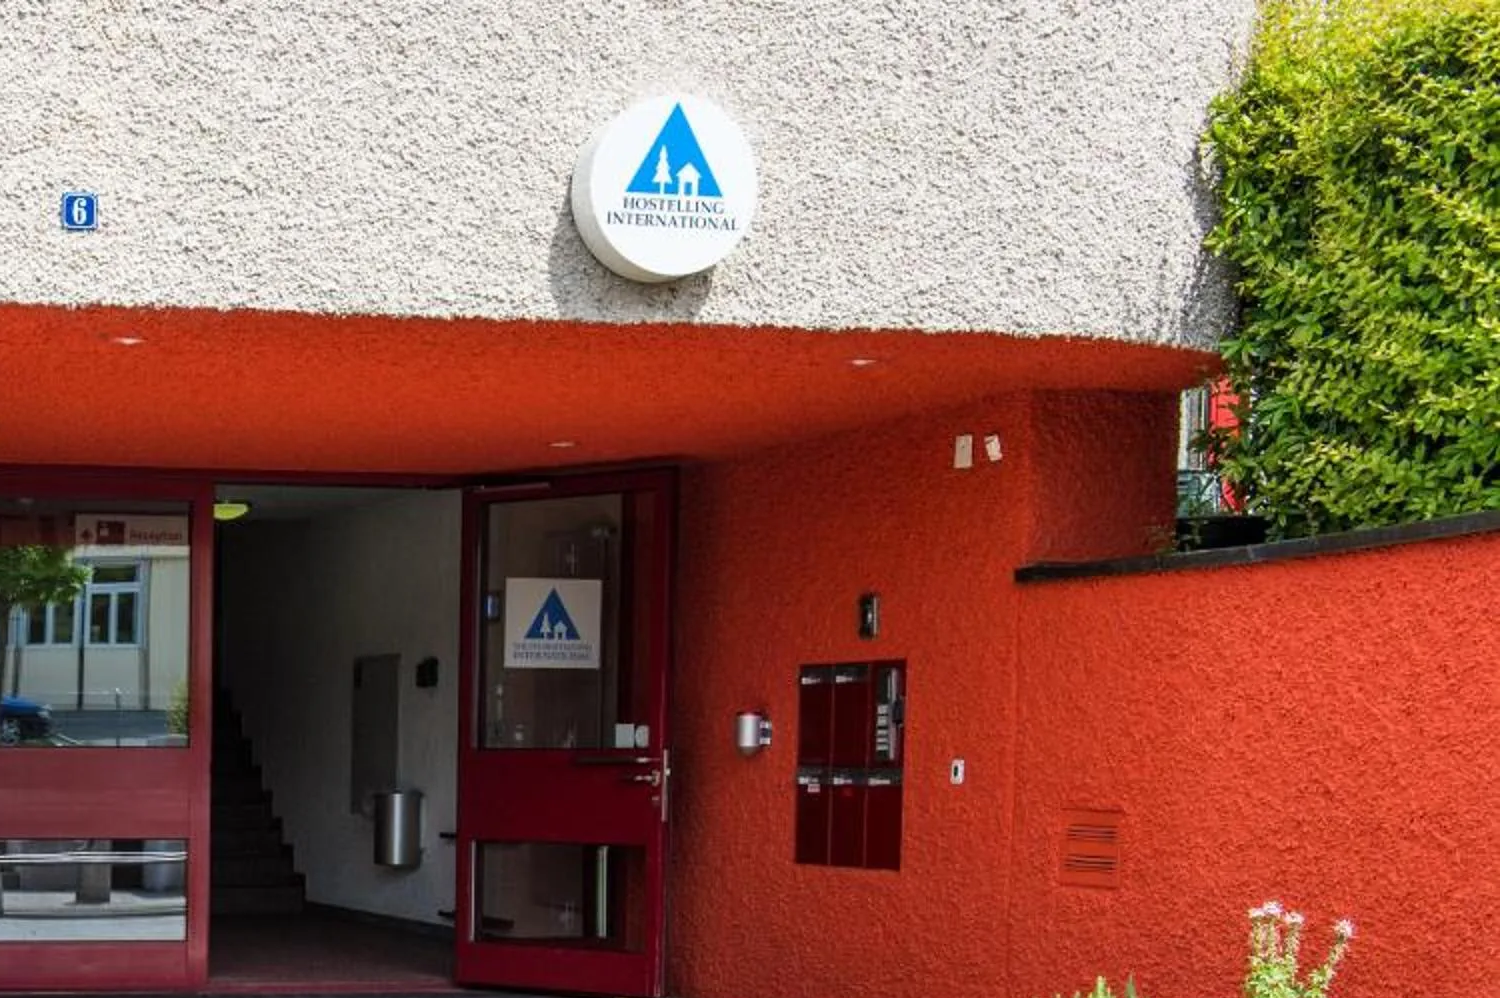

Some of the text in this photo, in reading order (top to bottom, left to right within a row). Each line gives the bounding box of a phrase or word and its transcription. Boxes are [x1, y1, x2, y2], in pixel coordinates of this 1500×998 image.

[73, 198, 87, 225] 6
[623, 197, 725, 214] HOSTELLING
[607, 211, 739, 231] INTERNATIONAL
